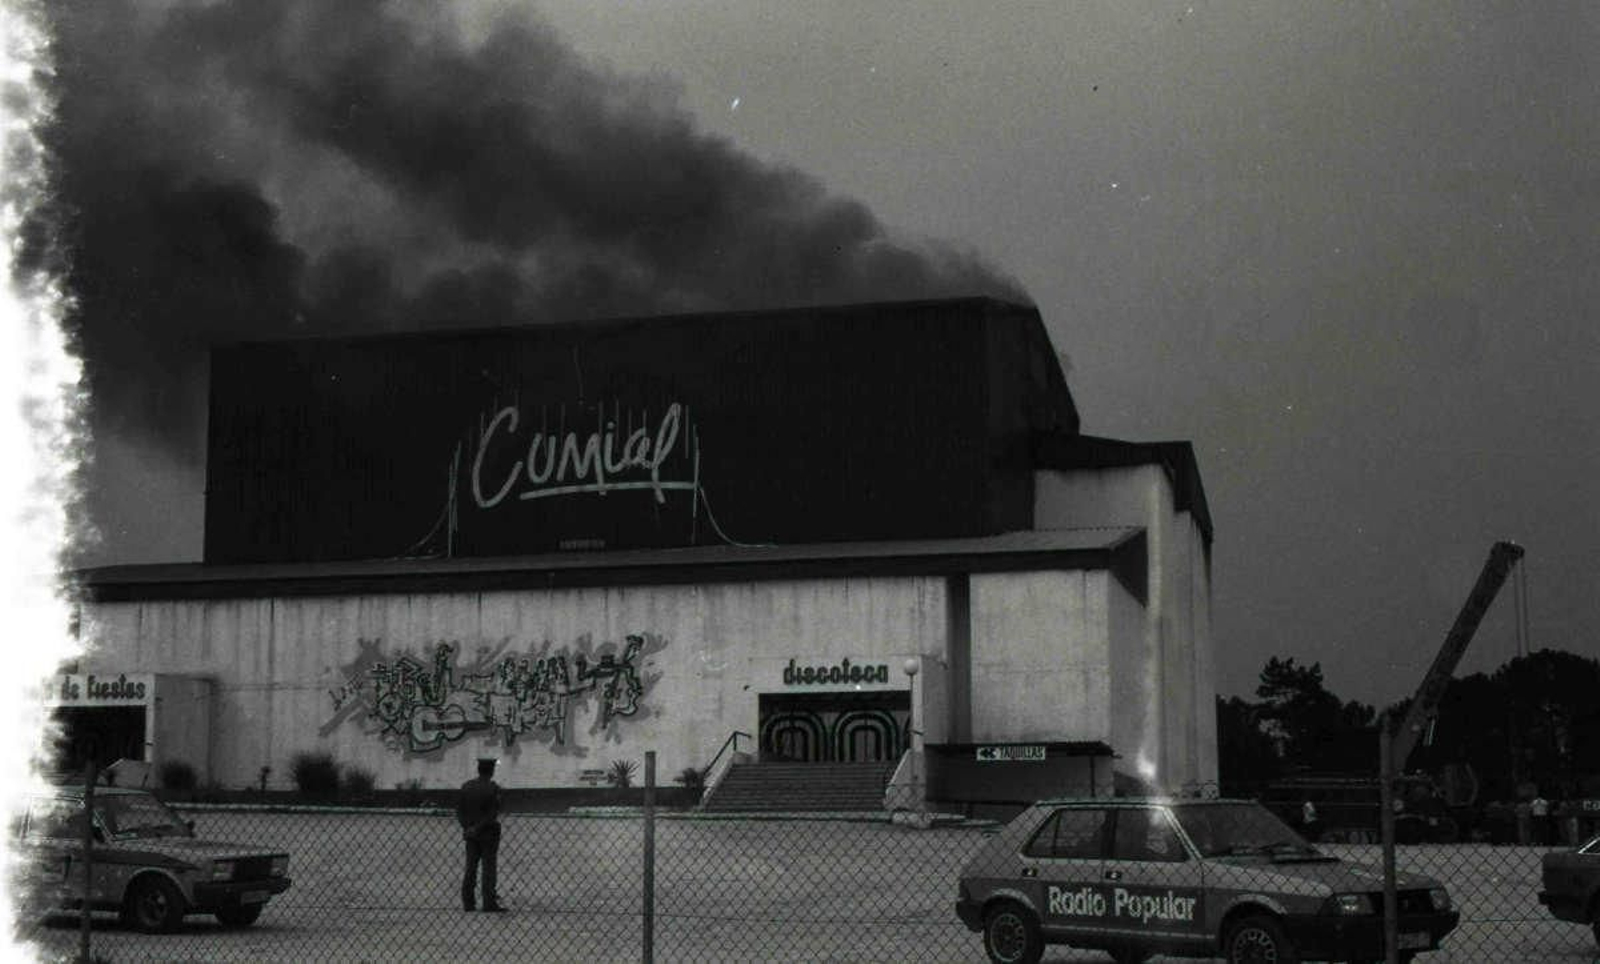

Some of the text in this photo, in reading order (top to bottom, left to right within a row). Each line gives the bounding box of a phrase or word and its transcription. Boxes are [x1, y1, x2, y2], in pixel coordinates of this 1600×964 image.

[783, 656, 889, 685] discoteca
[61, 675, 80, 700] de
[1048, 885, 1197, 925] Radio Popular
